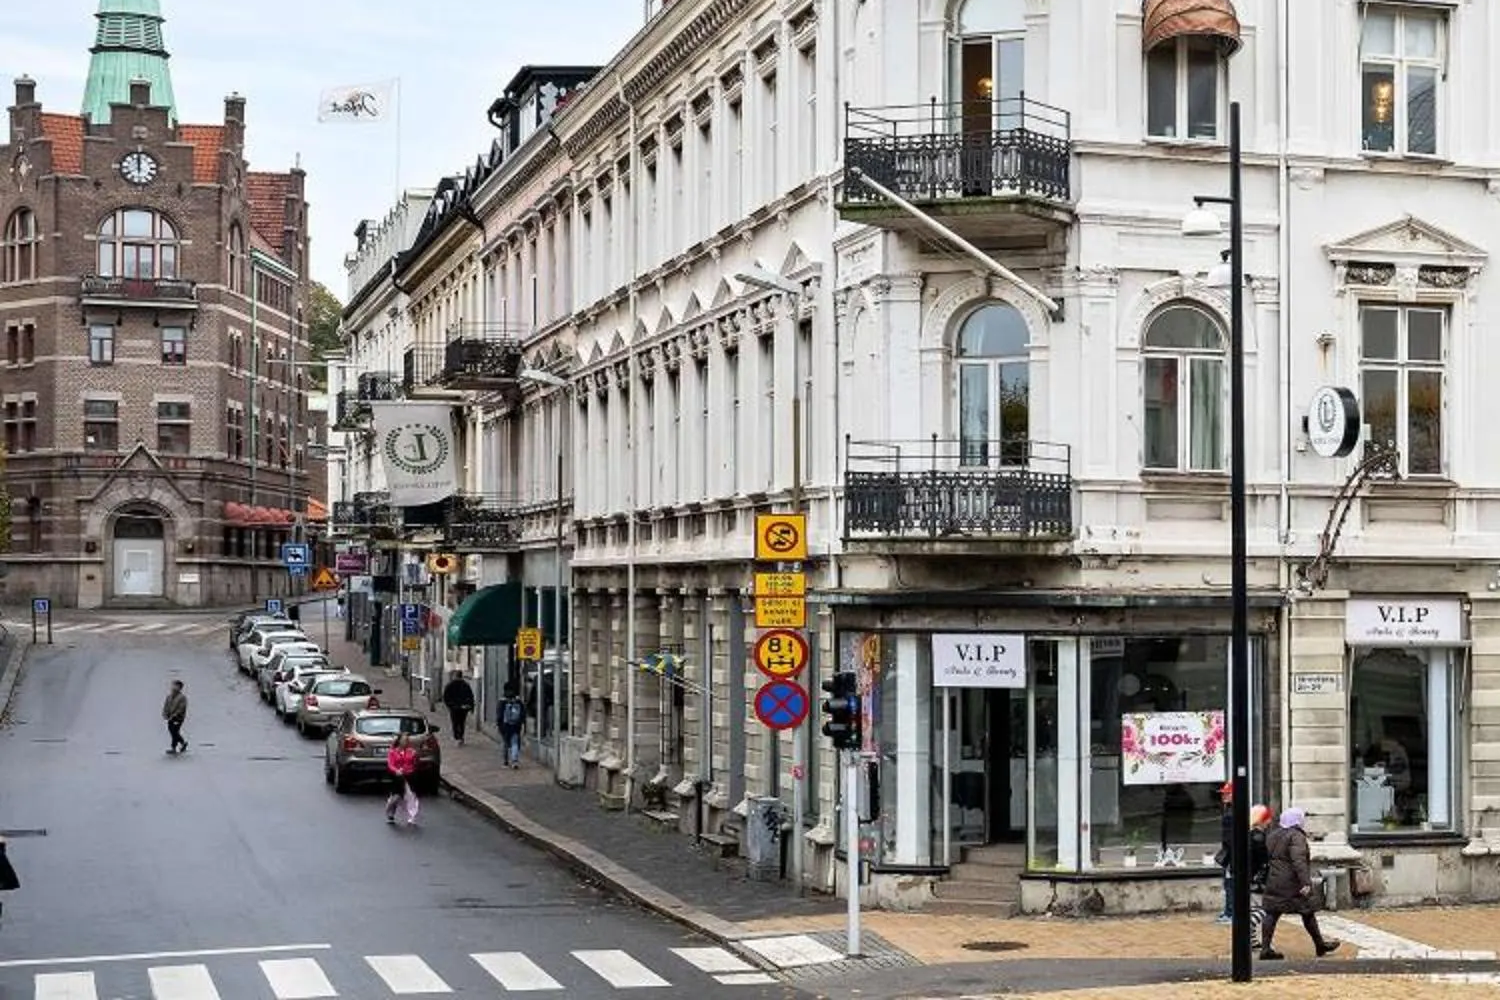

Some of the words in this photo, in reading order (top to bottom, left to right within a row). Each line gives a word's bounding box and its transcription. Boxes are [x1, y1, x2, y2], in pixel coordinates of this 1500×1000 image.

[1377, 605, 1429, 622] V.I.P
[768, 638, 780, 652] 8
[955, 644, 1006, 662] V.I.P
[1151, 733, 1201, 746] 100kr
